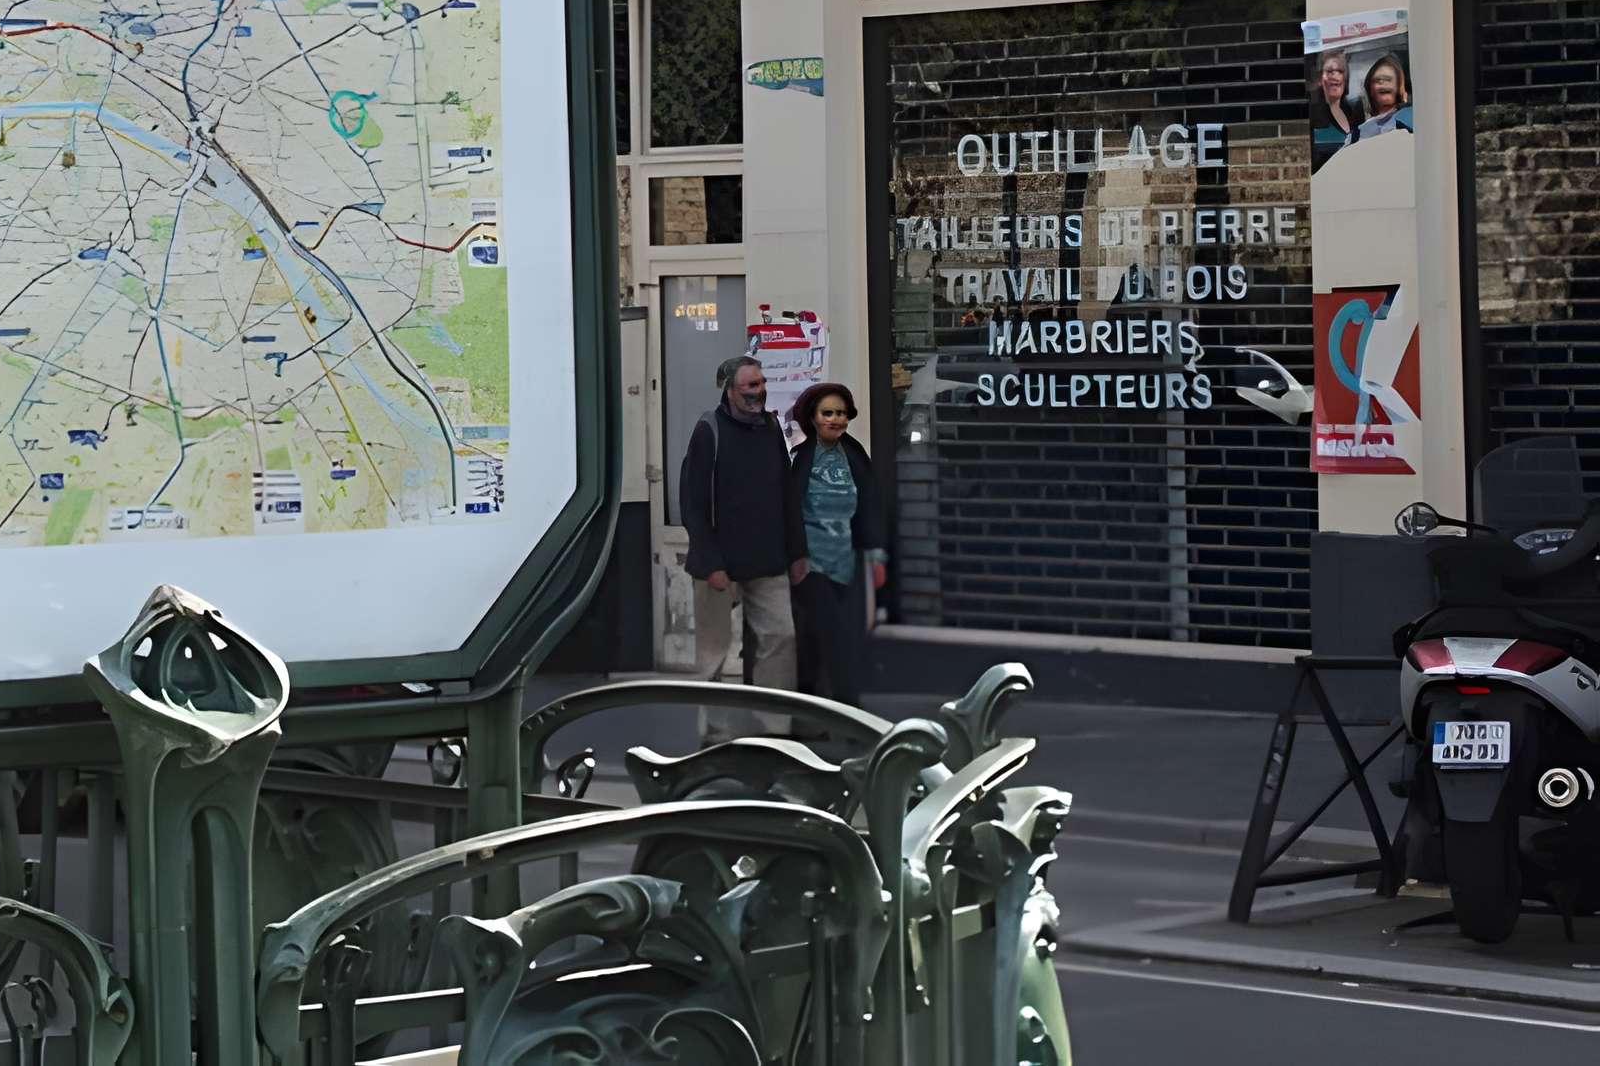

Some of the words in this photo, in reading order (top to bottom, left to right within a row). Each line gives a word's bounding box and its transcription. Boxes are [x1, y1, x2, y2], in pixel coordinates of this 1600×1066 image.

[957, 123, 1225, 176] OUTILLAGE
[946, 266, 1081, 304] TRAVAIL
[1161, 264, 1249, 301] BOIS
[987, 320, 1199, 355] MARBRIERS
[977, 372, 1213, 410] SCULPTEURS
